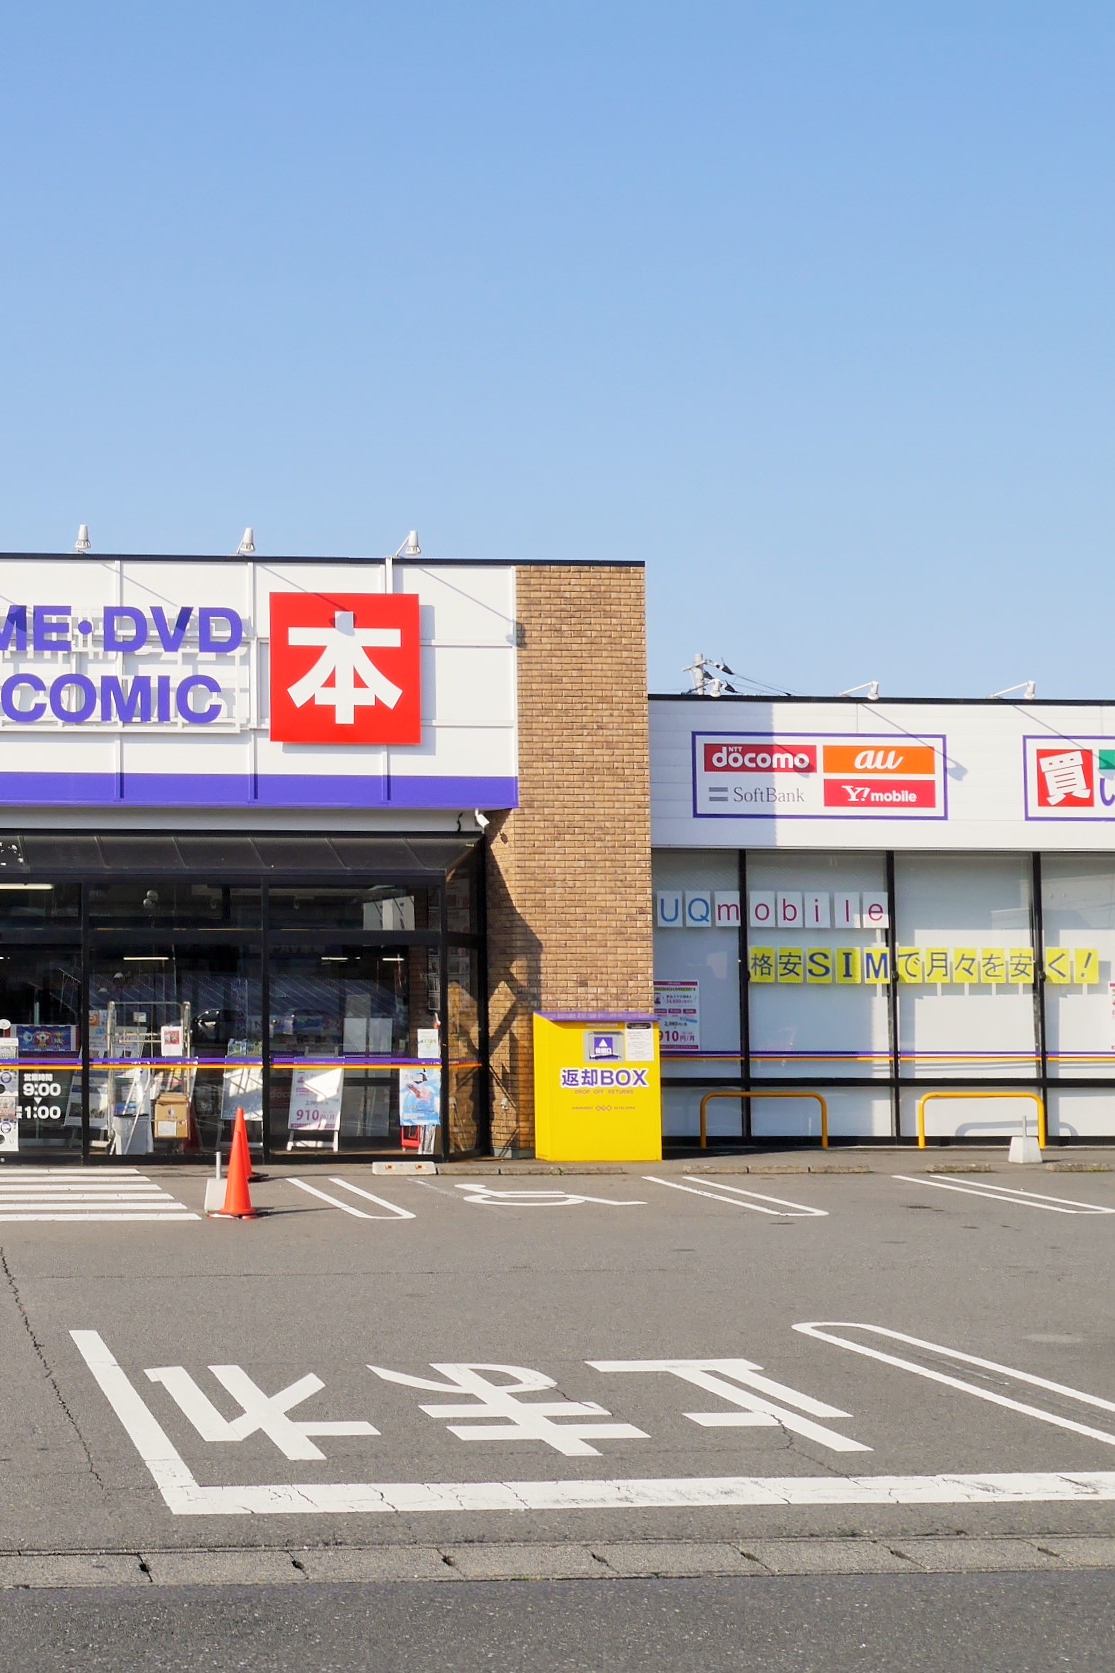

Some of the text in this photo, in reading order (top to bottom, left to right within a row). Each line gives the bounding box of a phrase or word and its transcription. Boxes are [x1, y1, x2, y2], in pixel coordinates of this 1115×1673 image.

[287, 611, 403, 725] 本
[712, 747, 810, 769] docomo
[854, 750, 903, 770] au
[733, 786, 805, 803] SoftBank
[562, 1069, 647, 1086] 返却BOX
[22, 1083, 62, 1096] 9:00
